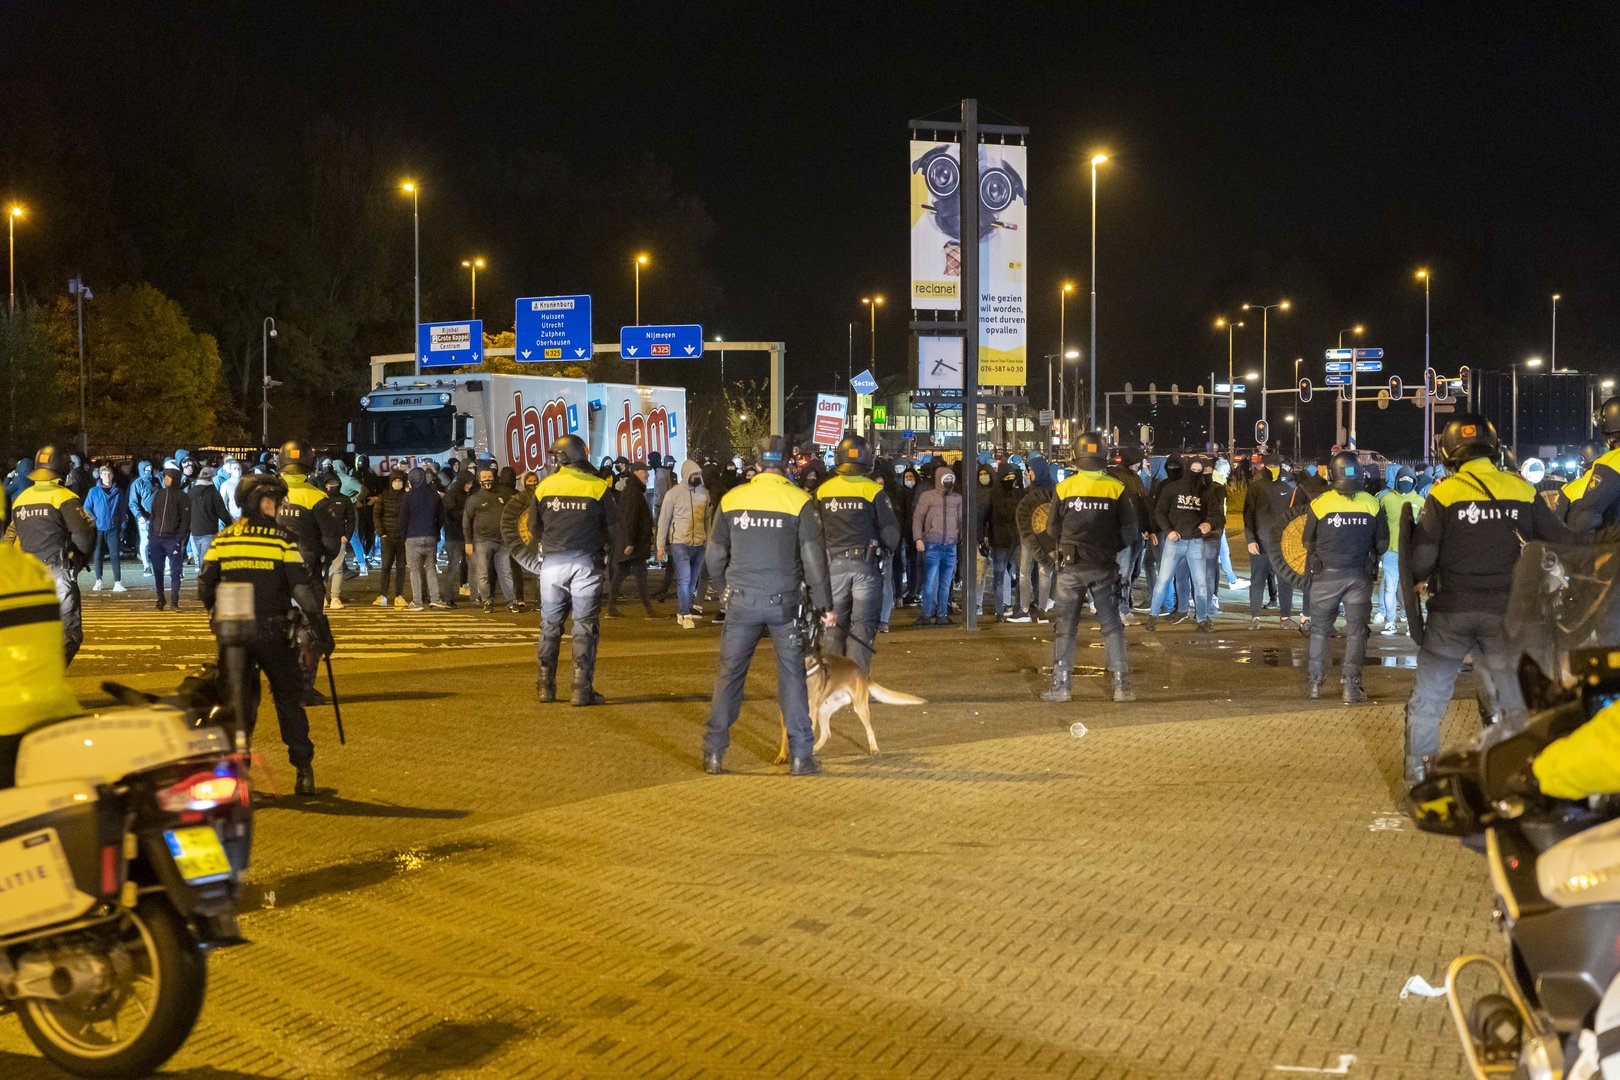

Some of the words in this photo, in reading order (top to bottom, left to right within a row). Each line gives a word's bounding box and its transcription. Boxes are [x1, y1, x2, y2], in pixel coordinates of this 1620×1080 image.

[915, 283, 956, 294] reclanet
[981, 294, 996, 302] Wie
[997, 294, 1022, 303] gezien
[539, 301, 573, 309] Kronenburg
[980, 304, 991, 312] wil
[992, 305, 1024, 314] worden,
[999, 316, 1025, 324] durven
[540, 330, 566, 338] Zutphen
[985, 326, 1018, 335] opvallen
[645, 332, 676, 341] Nijmegen
[393, 397, 422, 405] dam.nl
[818, 400, 841, 411] dam
[505, 391, 569, 476] dam
[616, 399, 669, 464] dam
[546, 497, 587, 511] POLITIE
[825, 498, 863, 512] POLITIE
[1068, 497, 1109, 511] POLITIE
[16, 505, 49, 520] POLITIE
[279, 509, 300, 517] ITIE
[733, 510, 783, 529] POLITIE
[1327, 513, 1368, 527] POLITIE
